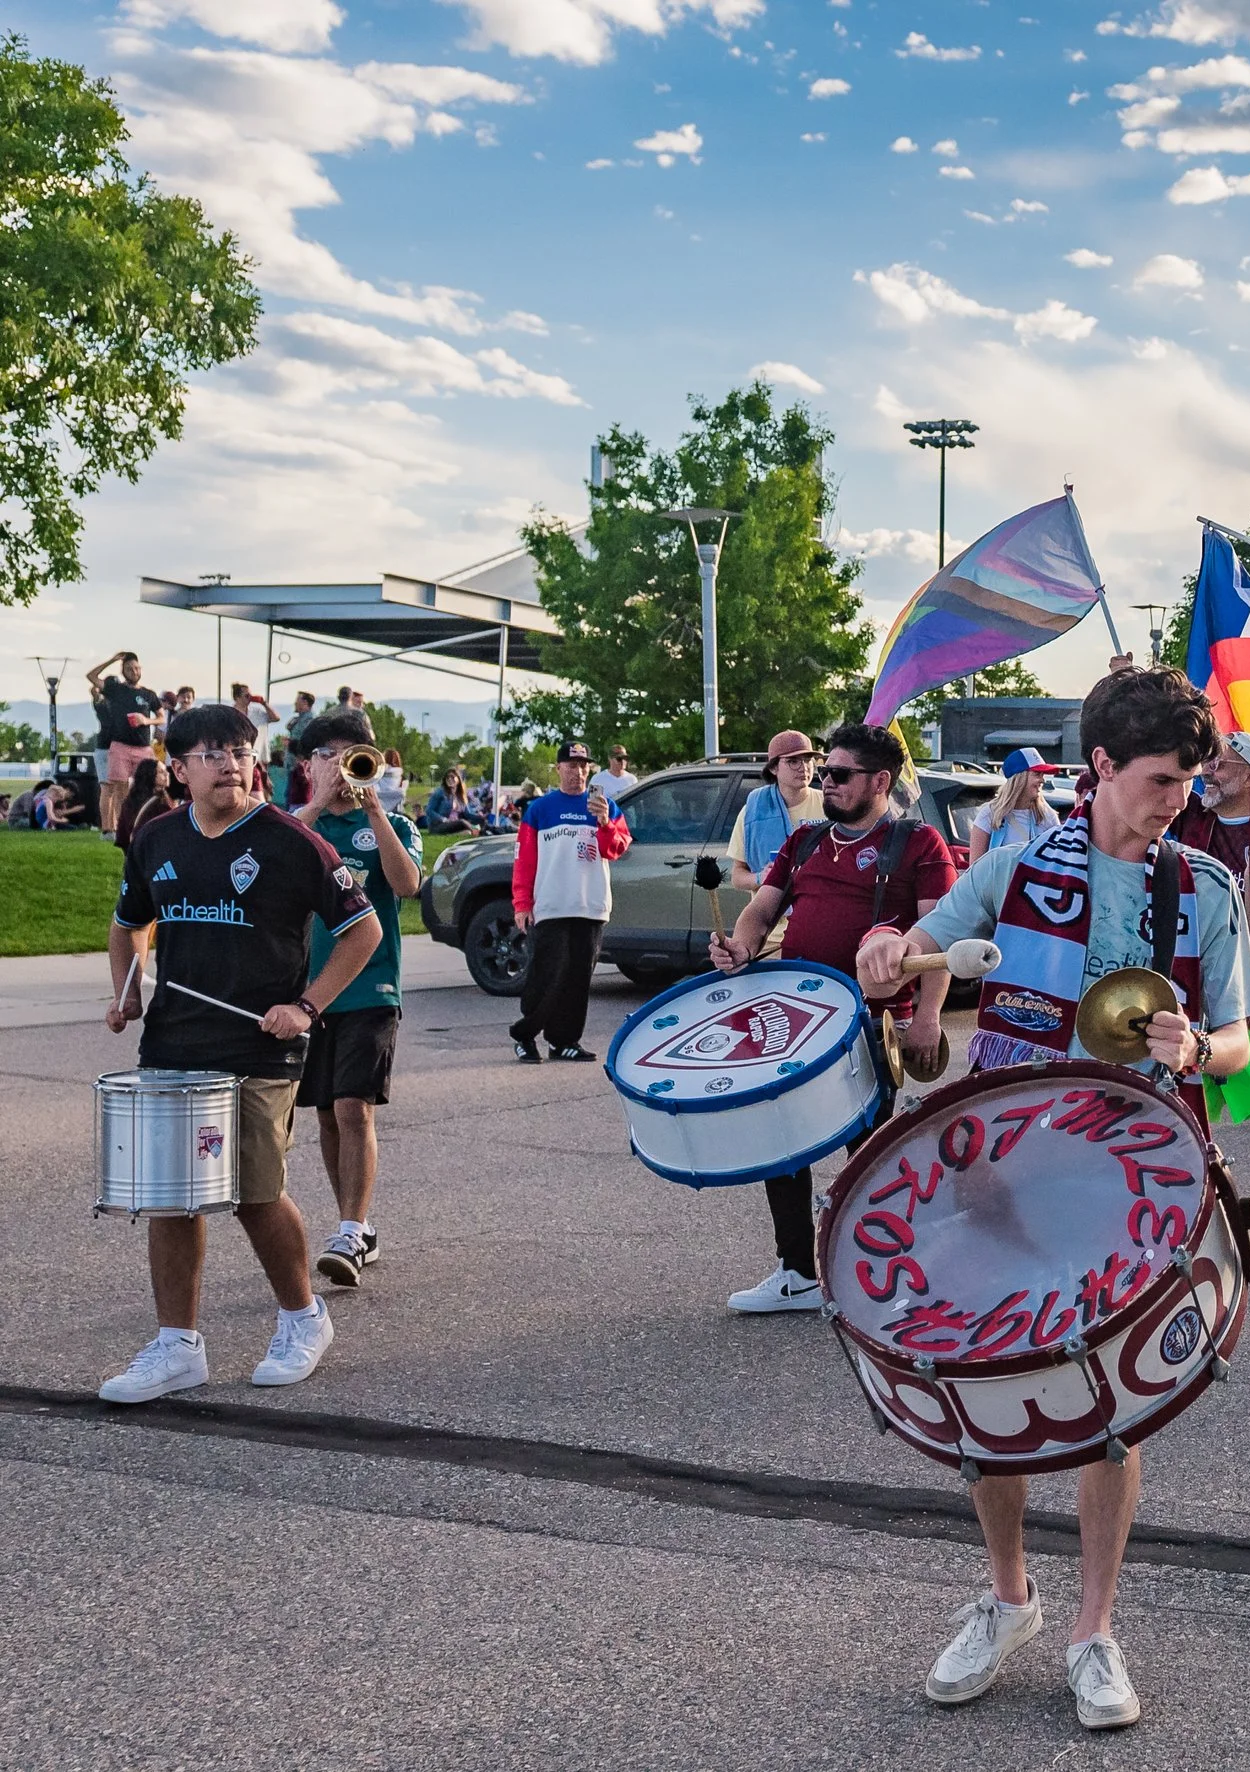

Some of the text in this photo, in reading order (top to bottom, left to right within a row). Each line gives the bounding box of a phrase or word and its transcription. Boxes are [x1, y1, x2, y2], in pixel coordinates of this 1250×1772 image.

[560, 812, 587, 820] adidas
[160, 897, 245, 923] uchealth
[747, 1017, 765, 1043] RAPIDS
[752, 1002, 793, 1056] COLORADO
[684, 1044, 695, 1055] 96
